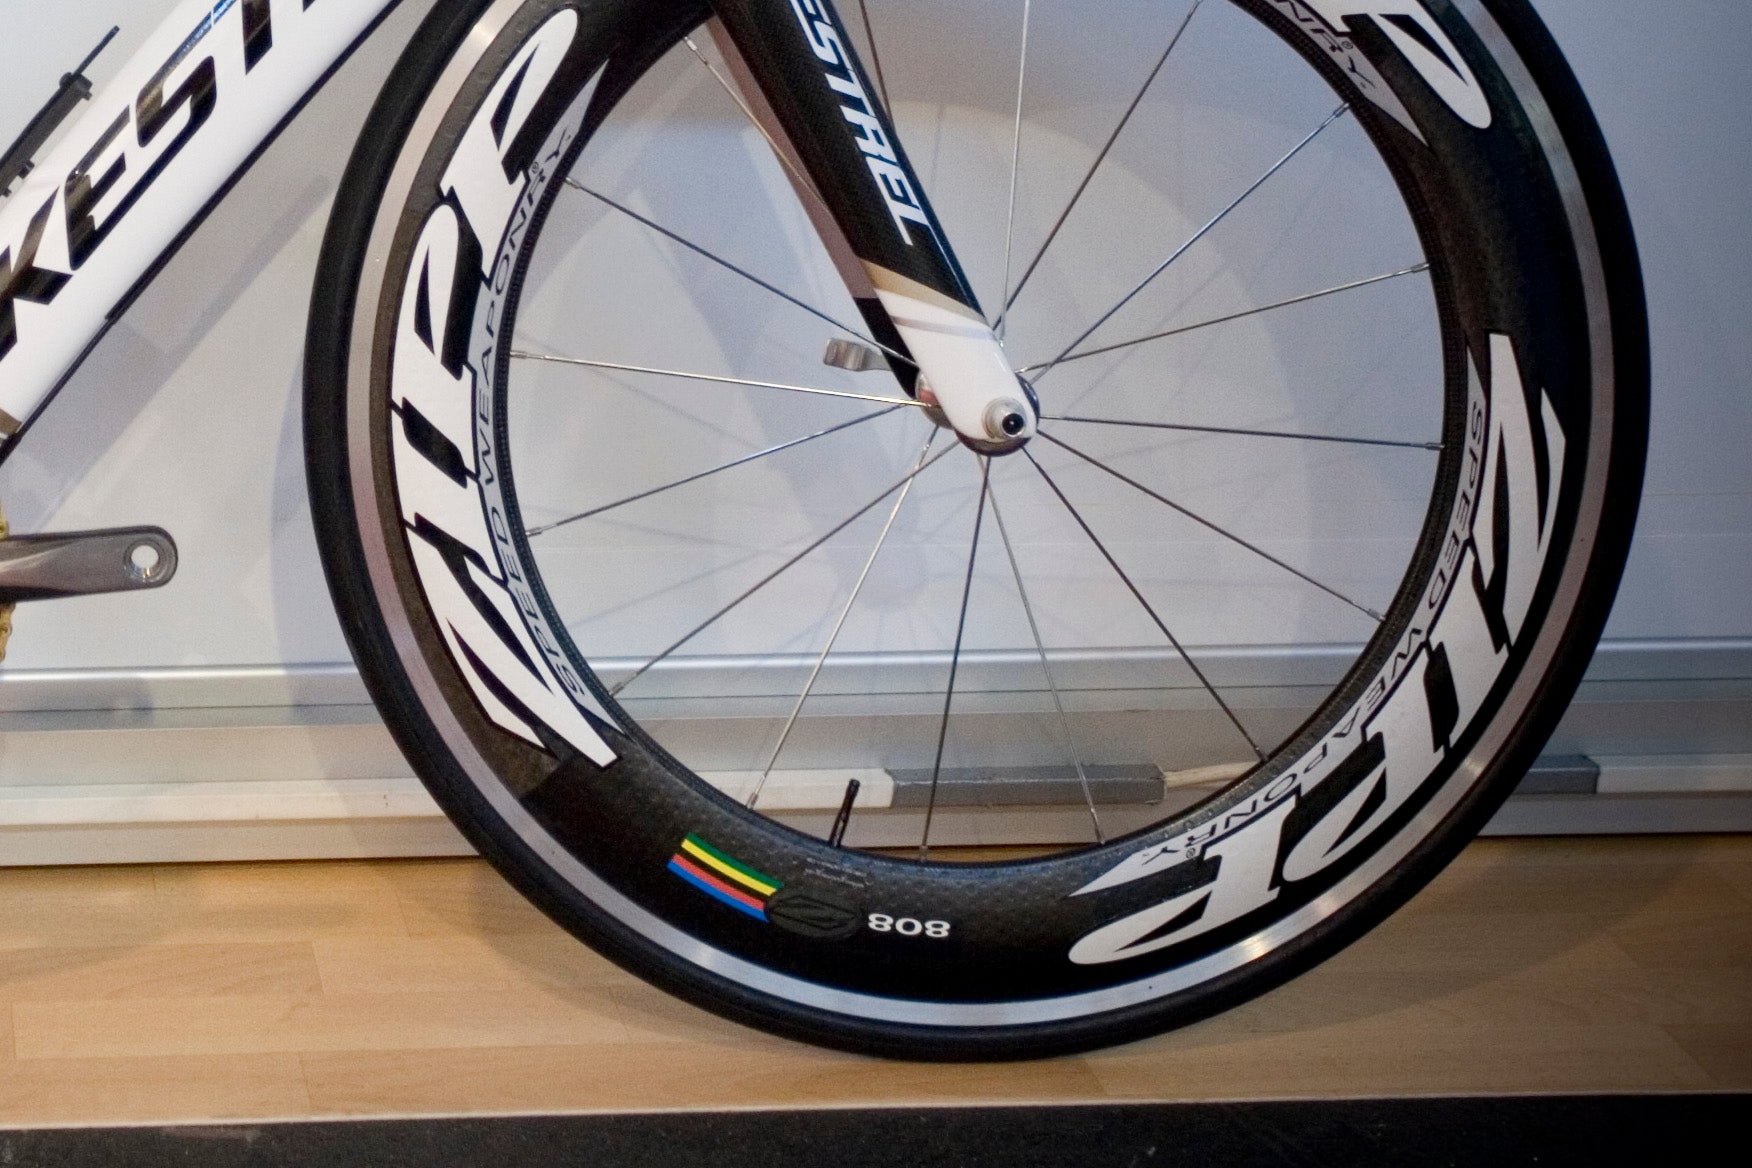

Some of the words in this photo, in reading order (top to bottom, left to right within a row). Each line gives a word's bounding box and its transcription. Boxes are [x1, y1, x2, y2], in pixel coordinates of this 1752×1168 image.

[391, 7, 620, 769] ZIPP
[476, 131, 572, 485] WEAPONRY
[489, 505, 584, 695] SPEED
[1427, 400, 1483, 611] SPEED
[1068, 332, 1567, 965] ZIPP
[1142, 626, 1424, 866] WEAPONRY
[867, 912, 952, 939] 808
